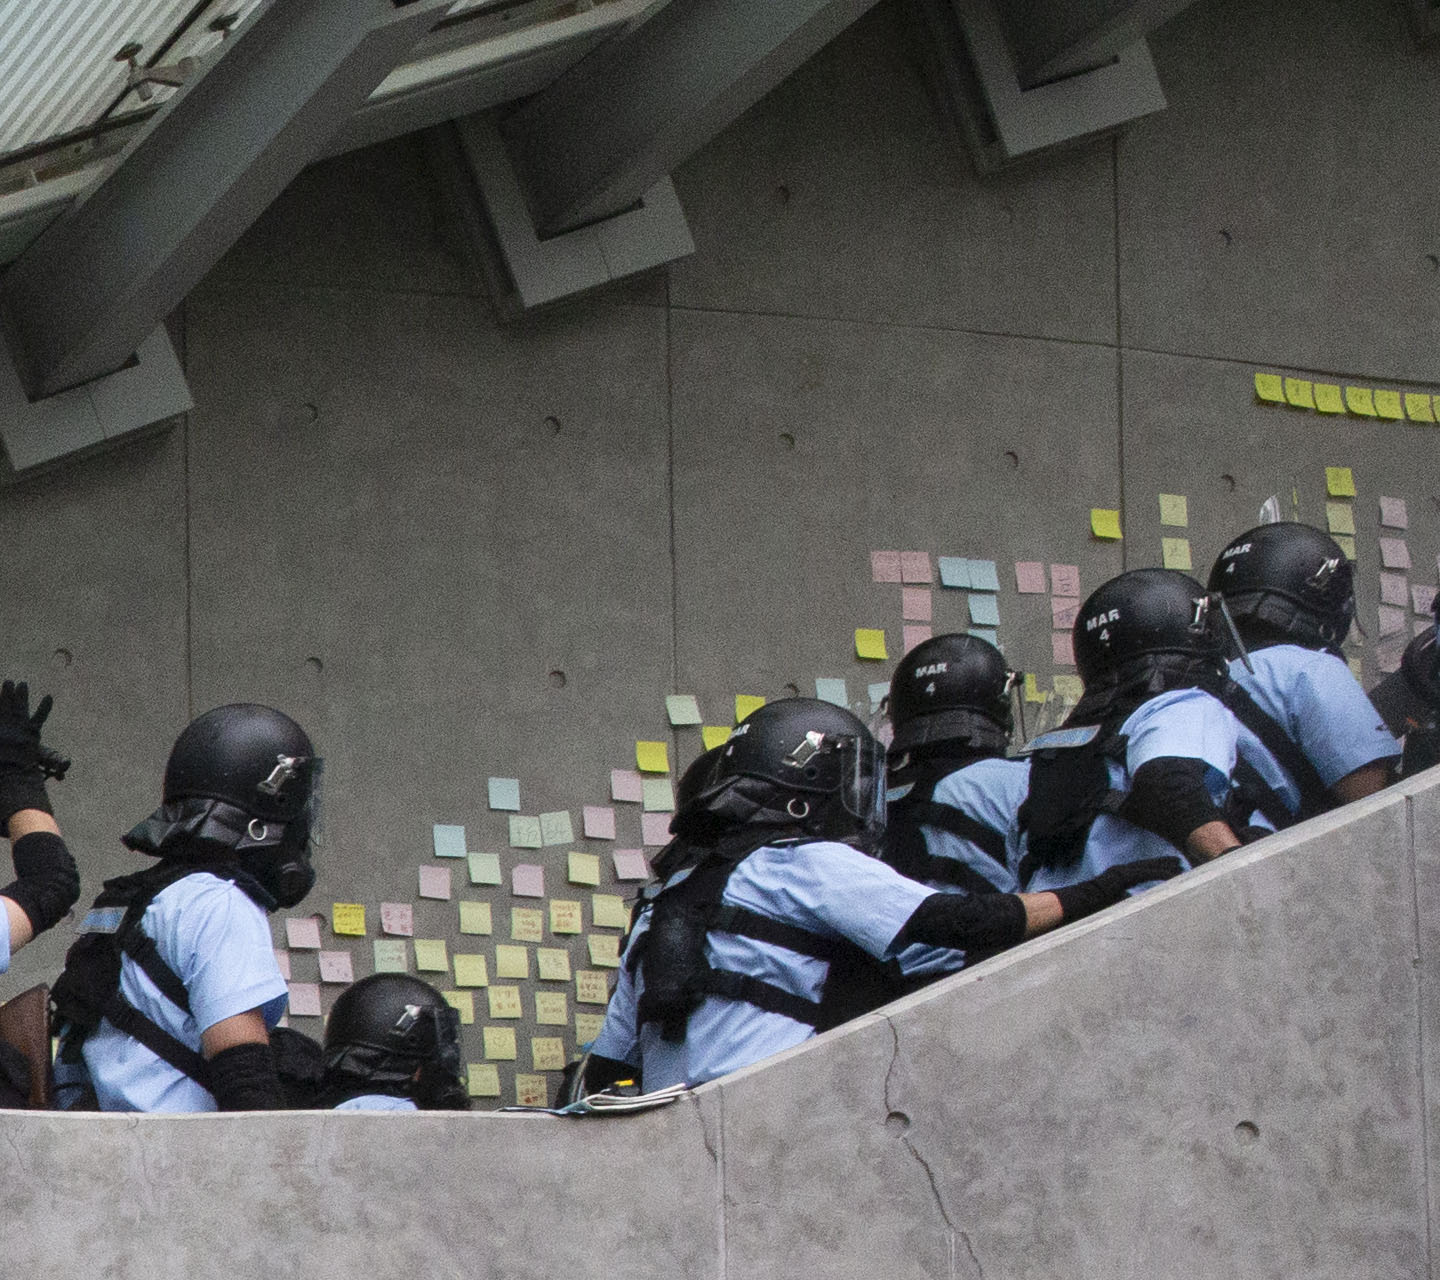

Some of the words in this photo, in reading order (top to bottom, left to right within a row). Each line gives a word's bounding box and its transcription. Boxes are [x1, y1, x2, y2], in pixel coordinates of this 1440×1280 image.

[1222, 542, 1253, 560] MAR
[1085, 608, 1121, 632] MAR
[1099, 627, 1110, 643] 4
[915, 662, 948, 678] MAR
[925, 681, 936, 695] 4
